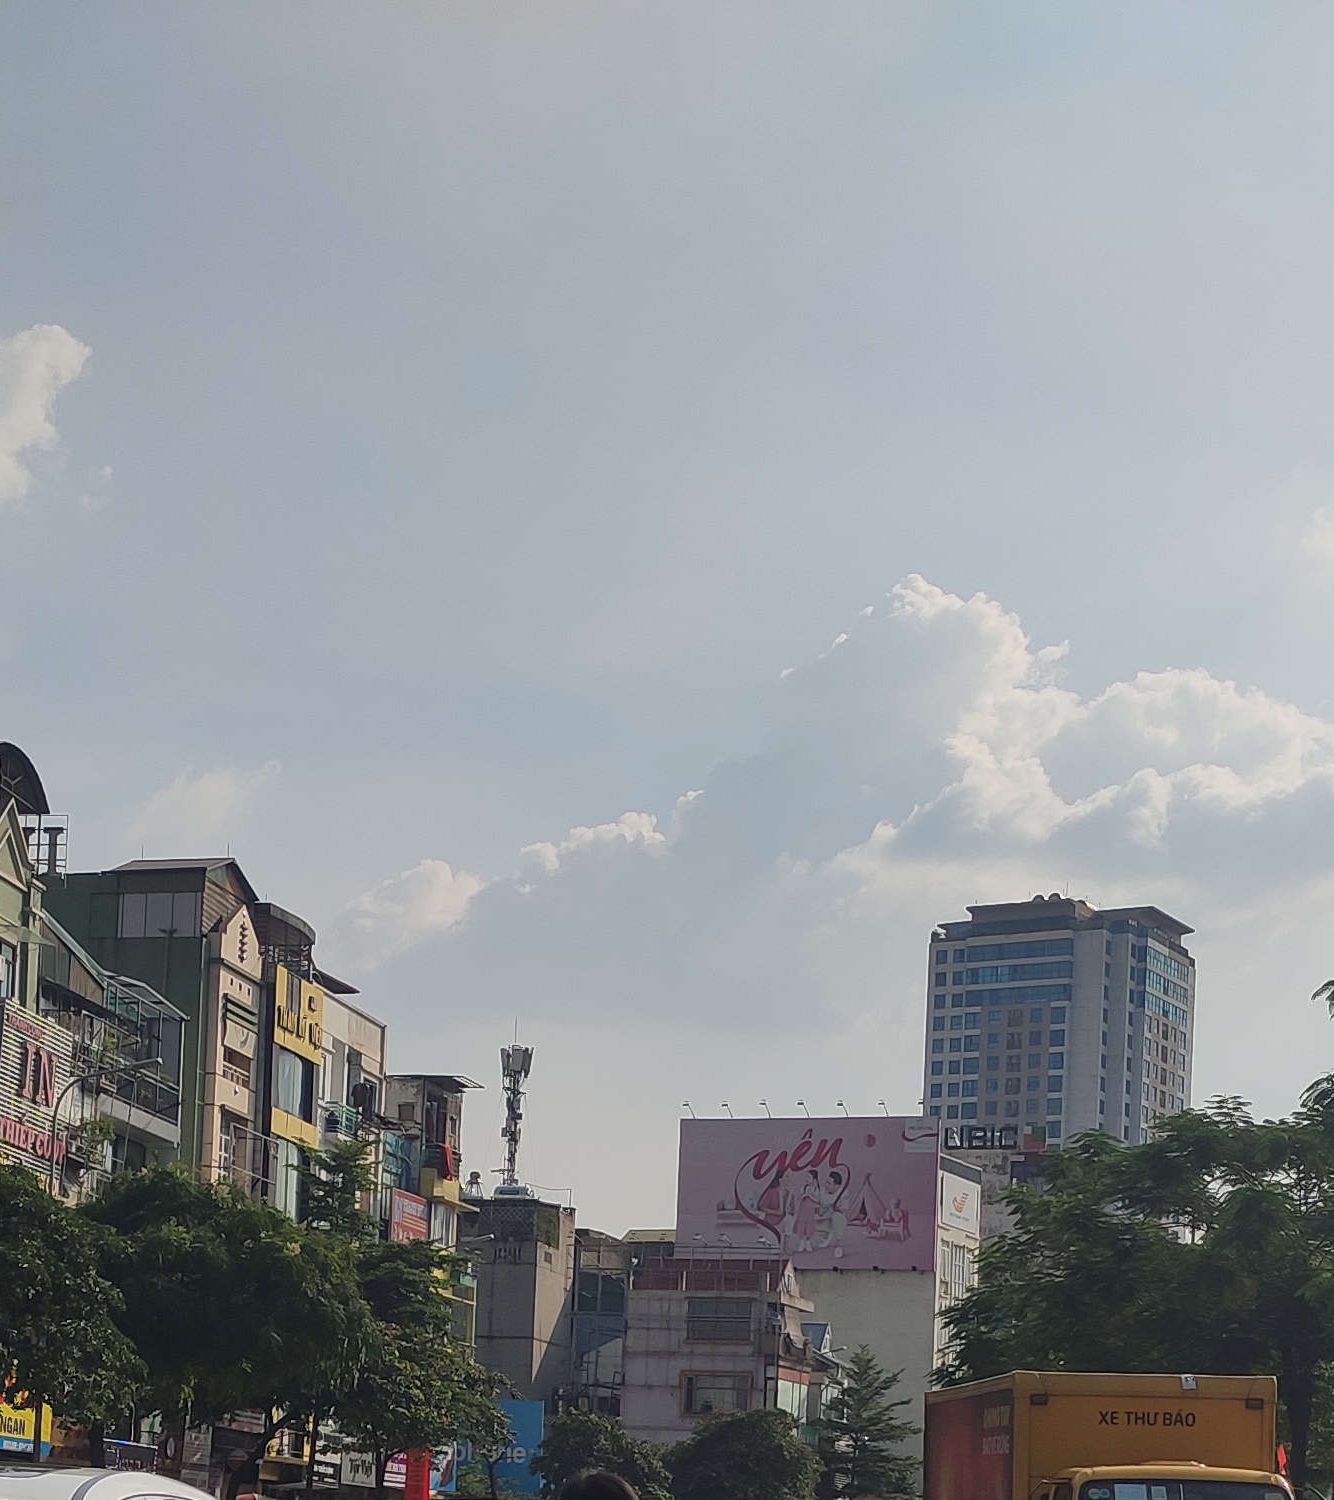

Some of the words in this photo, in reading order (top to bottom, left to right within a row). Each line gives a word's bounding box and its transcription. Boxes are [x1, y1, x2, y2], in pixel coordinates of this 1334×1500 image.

[21, 1042, 60, 1108] IN
[1098, 1410, 1119, 1425] XE
[1125, 1411, 1160, 1426] THƯ
[1163, 1409, 1196, 1427] BÁO
